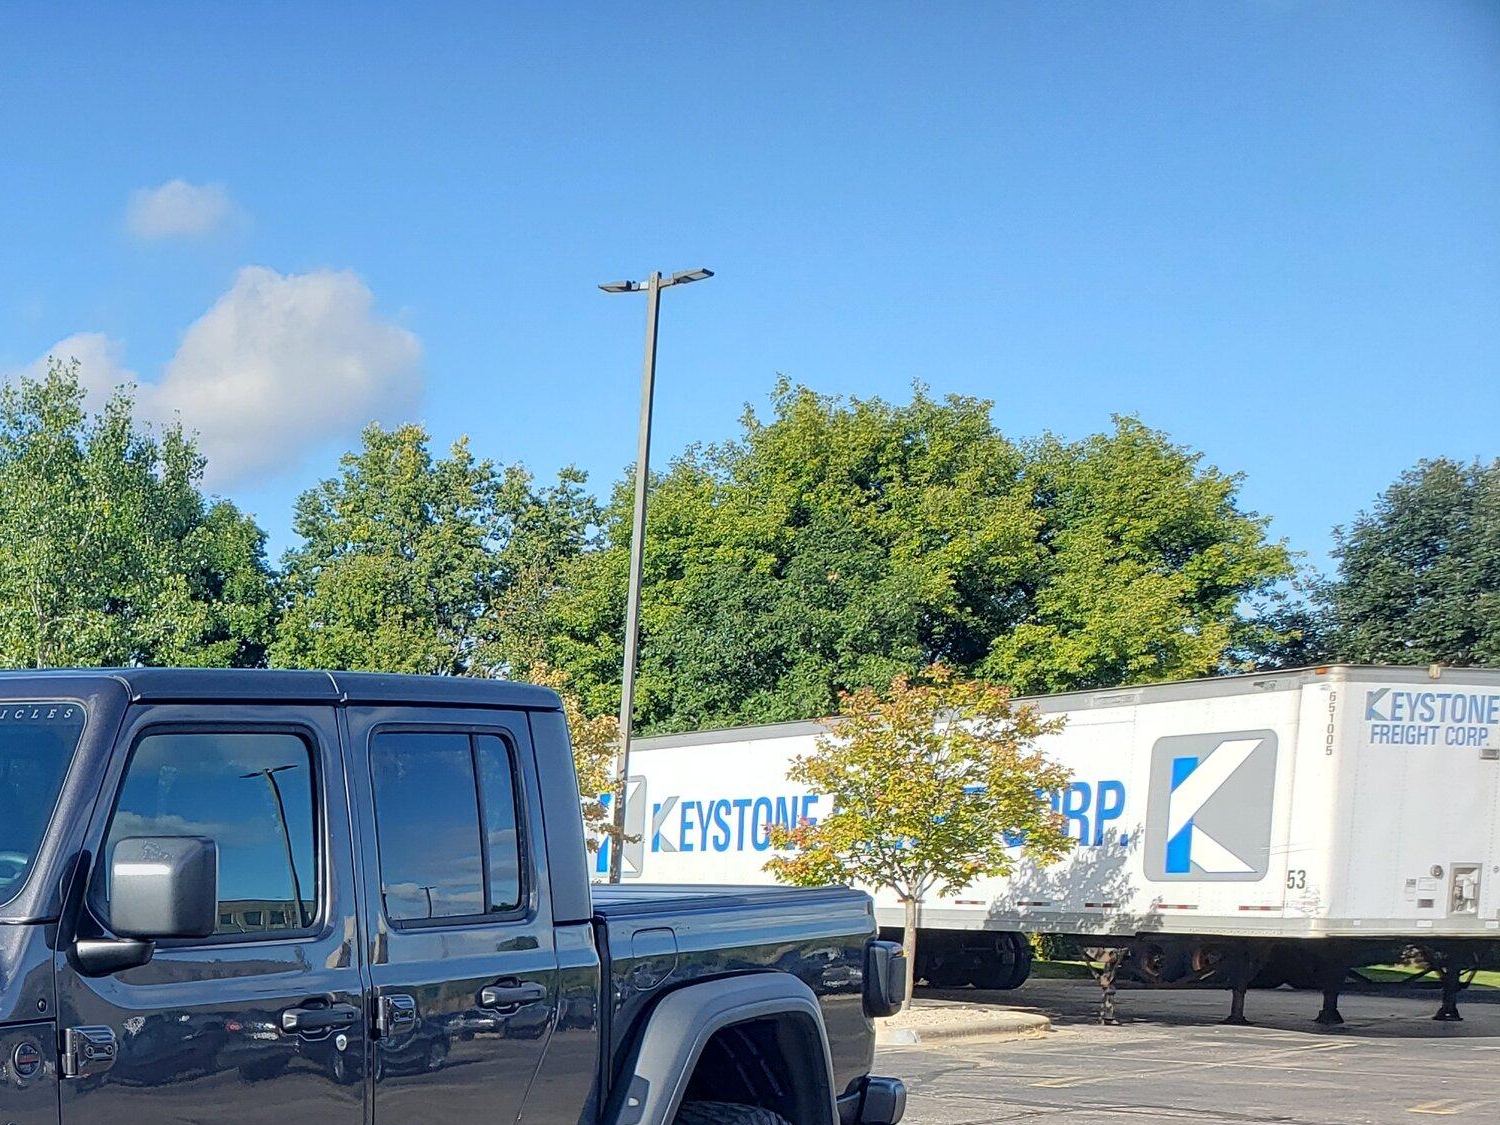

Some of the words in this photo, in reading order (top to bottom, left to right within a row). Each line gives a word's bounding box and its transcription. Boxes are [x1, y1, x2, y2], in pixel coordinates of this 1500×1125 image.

[1365, 688, 1500, 724] KEYSTONE
[1325, 691, 1337, 756] 651005
[1370, 724, 1440, 745] FREIGHT
[1445, 726, 1490, 747] CORP.
[1286, 869, 1307, 890] 53
